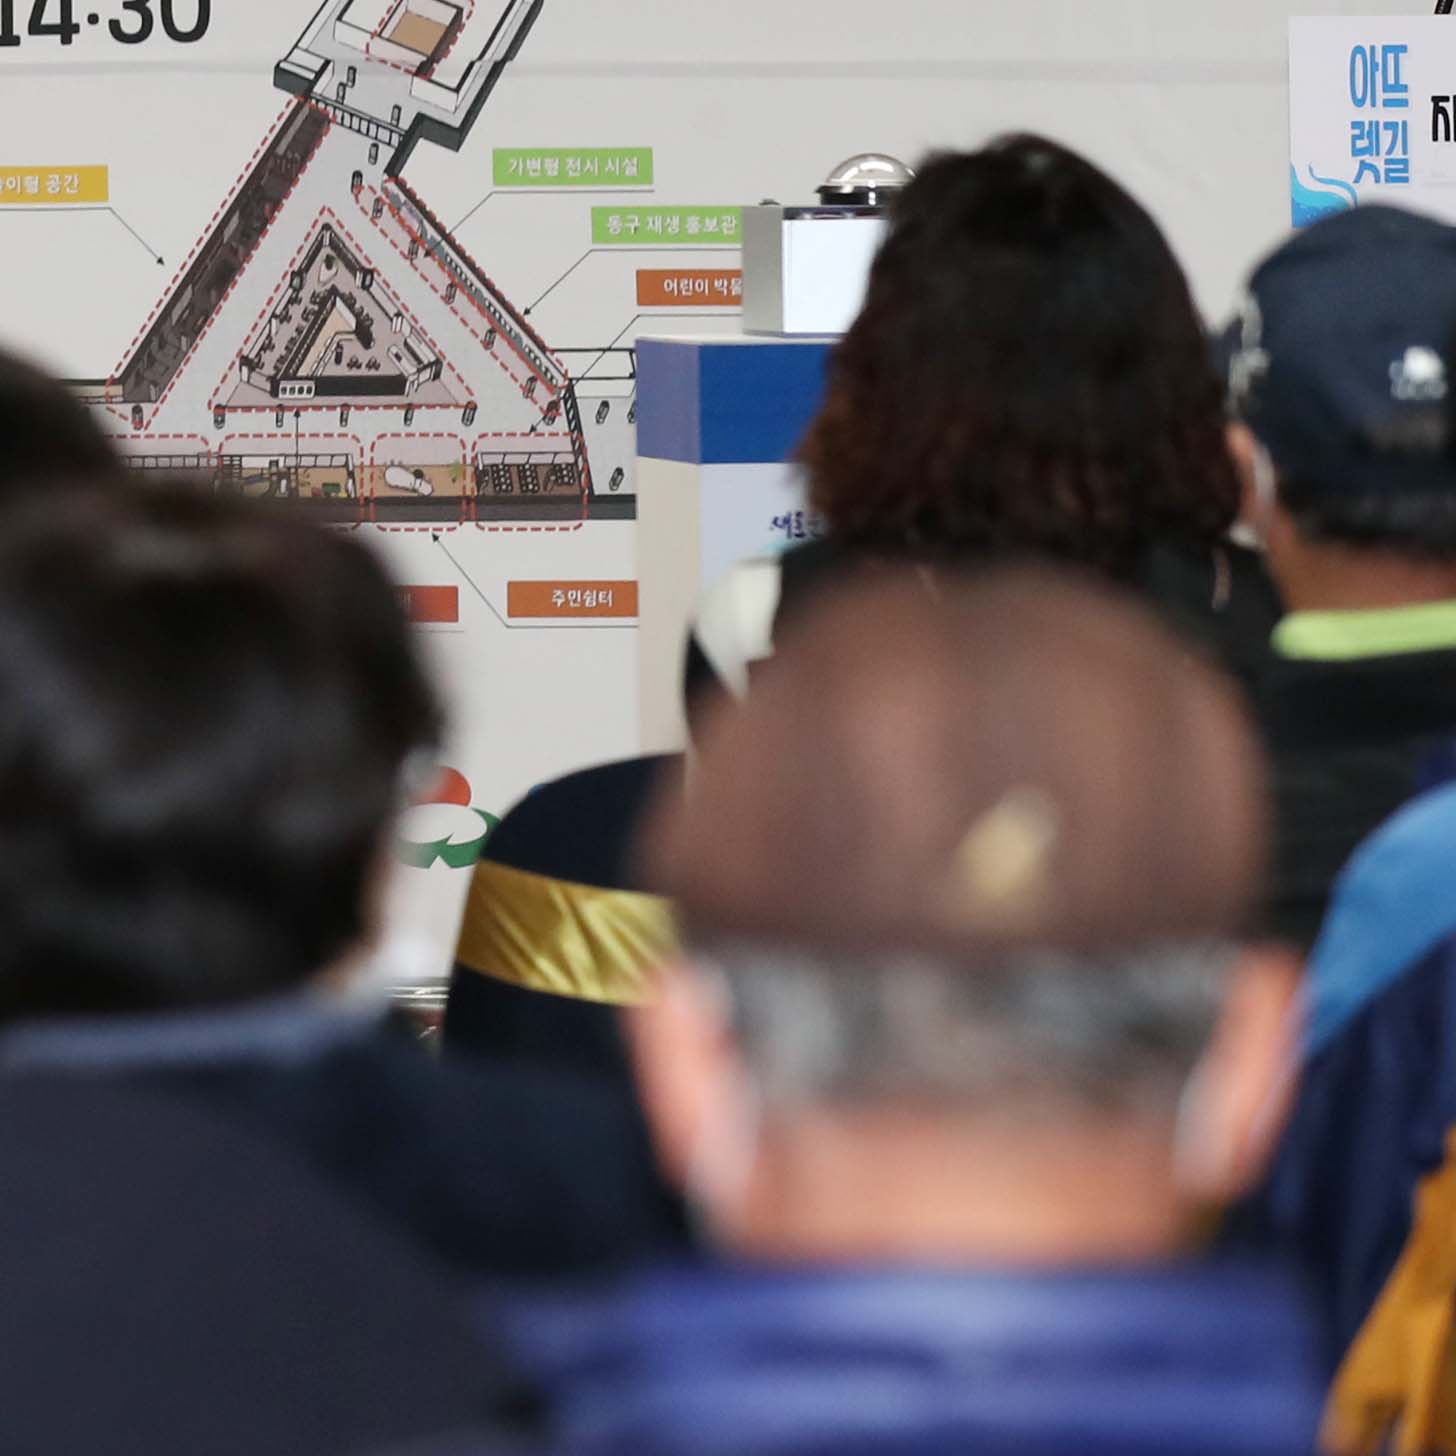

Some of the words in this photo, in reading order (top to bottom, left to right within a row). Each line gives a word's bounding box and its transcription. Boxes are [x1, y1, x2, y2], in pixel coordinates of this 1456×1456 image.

[1349, 44, 1410, 108] 아뜨
[1350, 120, 1410, 184] 렛길
[566, 157, 600, 178] 전시
[46, 173, 80, 194] 공간
[663, 276, 710, 298] 어린이
[551, 588, 615, 610] 주민쉼터
